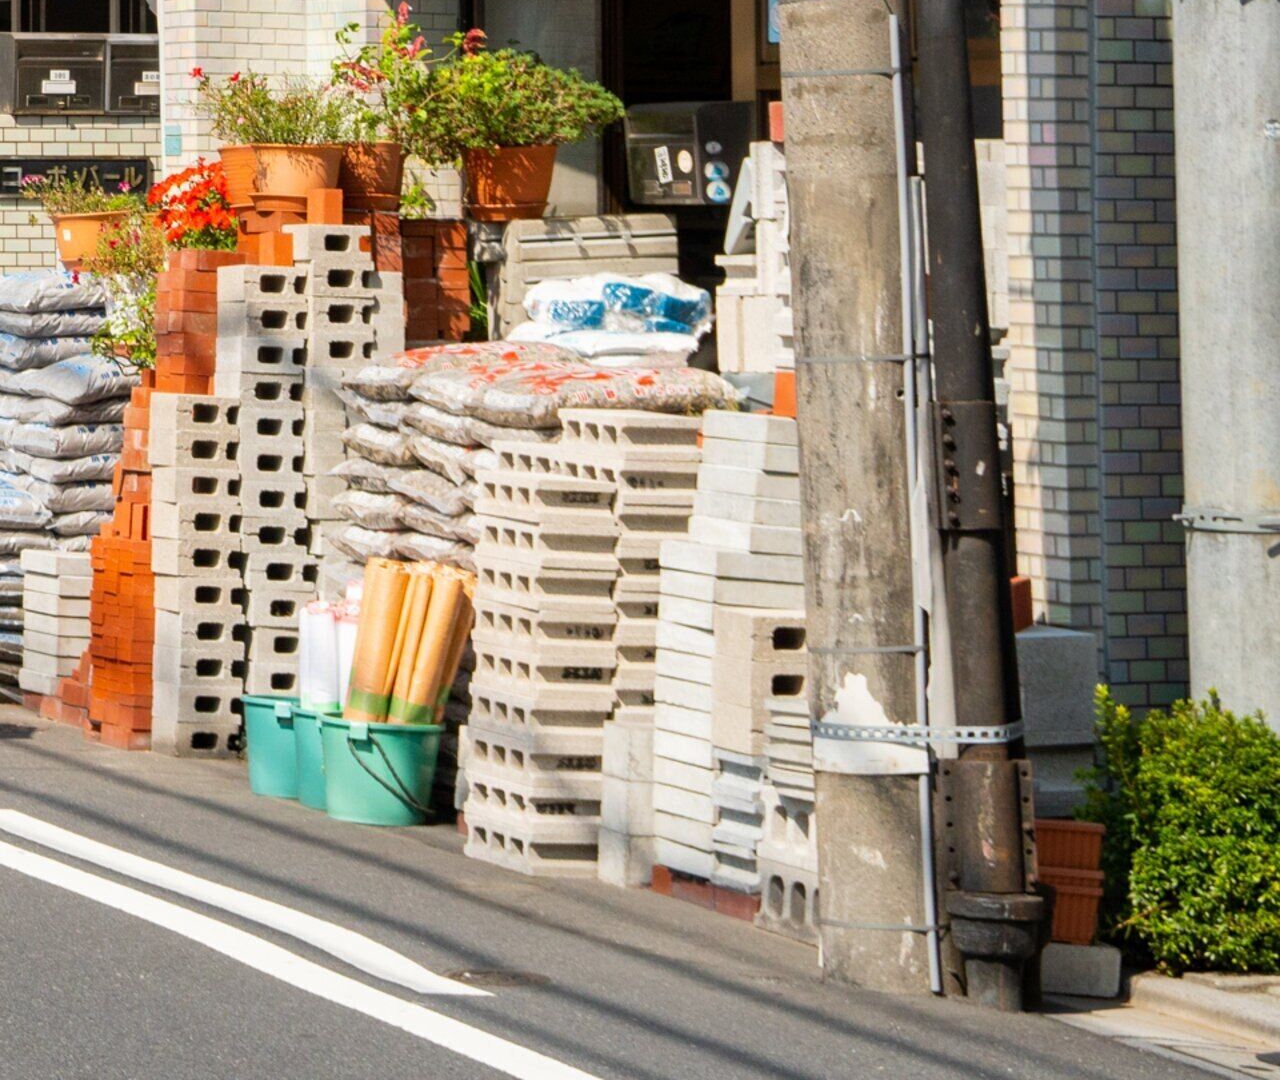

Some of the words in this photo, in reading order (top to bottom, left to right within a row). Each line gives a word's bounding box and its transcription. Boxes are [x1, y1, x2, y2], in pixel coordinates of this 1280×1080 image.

[2, 164, 144, 188] コポバール
